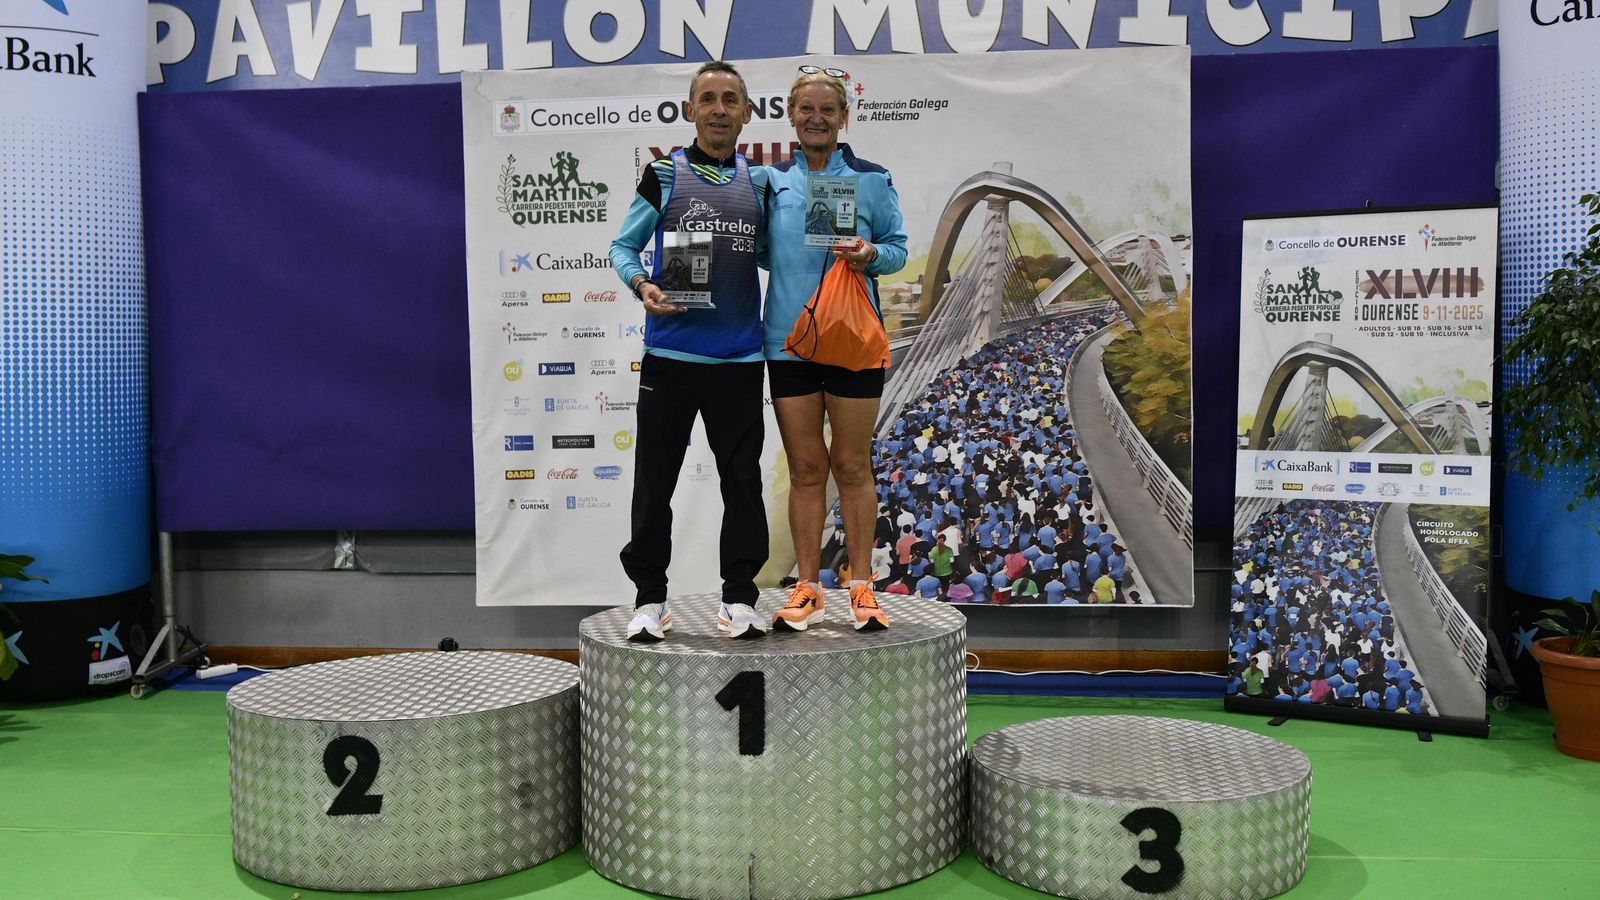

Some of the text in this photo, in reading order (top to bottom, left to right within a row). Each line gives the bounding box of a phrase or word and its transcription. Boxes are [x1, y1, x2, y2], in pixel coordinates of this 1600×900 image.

[1530, 0, 1600, 26] Cai
[0, 36, 97, 78] Bank
[857, 98, 949, 111] Federación Galega
[531, 106, 620, 127] Concello
[628, 104, 652, 123] de
[857, 111, 920, 122] de Atletismo
[512, 174, 552, 188] SAN
[512, 201, 607, 211] CARREIRA PEDESTRE POPULAR
[512, 209, 608, 225] OURENSE
[685, 218, 756, 235] castrelos
[731, 238, 755, 252] 20:30
[1279, 234, 1406, 250] Concello de OURENSE
[536, 252, 613, 271] CaixaBan
[1266, 283, 1299, 294] SAN
[1365, 267, 1479, 299] XLVIII
[1265, 311, 1341, 323] OURENSE
[1362, 303, 1484, 321] OURENSE 9-11-2025
[549, 365, 573, 373] VIAQUA
[1277, 459, 1333, 473] CaixaBank
[506, 470, 534, 479] GADIS
[1420, 529, 1479, 537] HOMOLOGADO
[715, 670, 766, 757] 1
[322, 735, 384, 817] 2
[1119, 806, 1185, 894] 3
